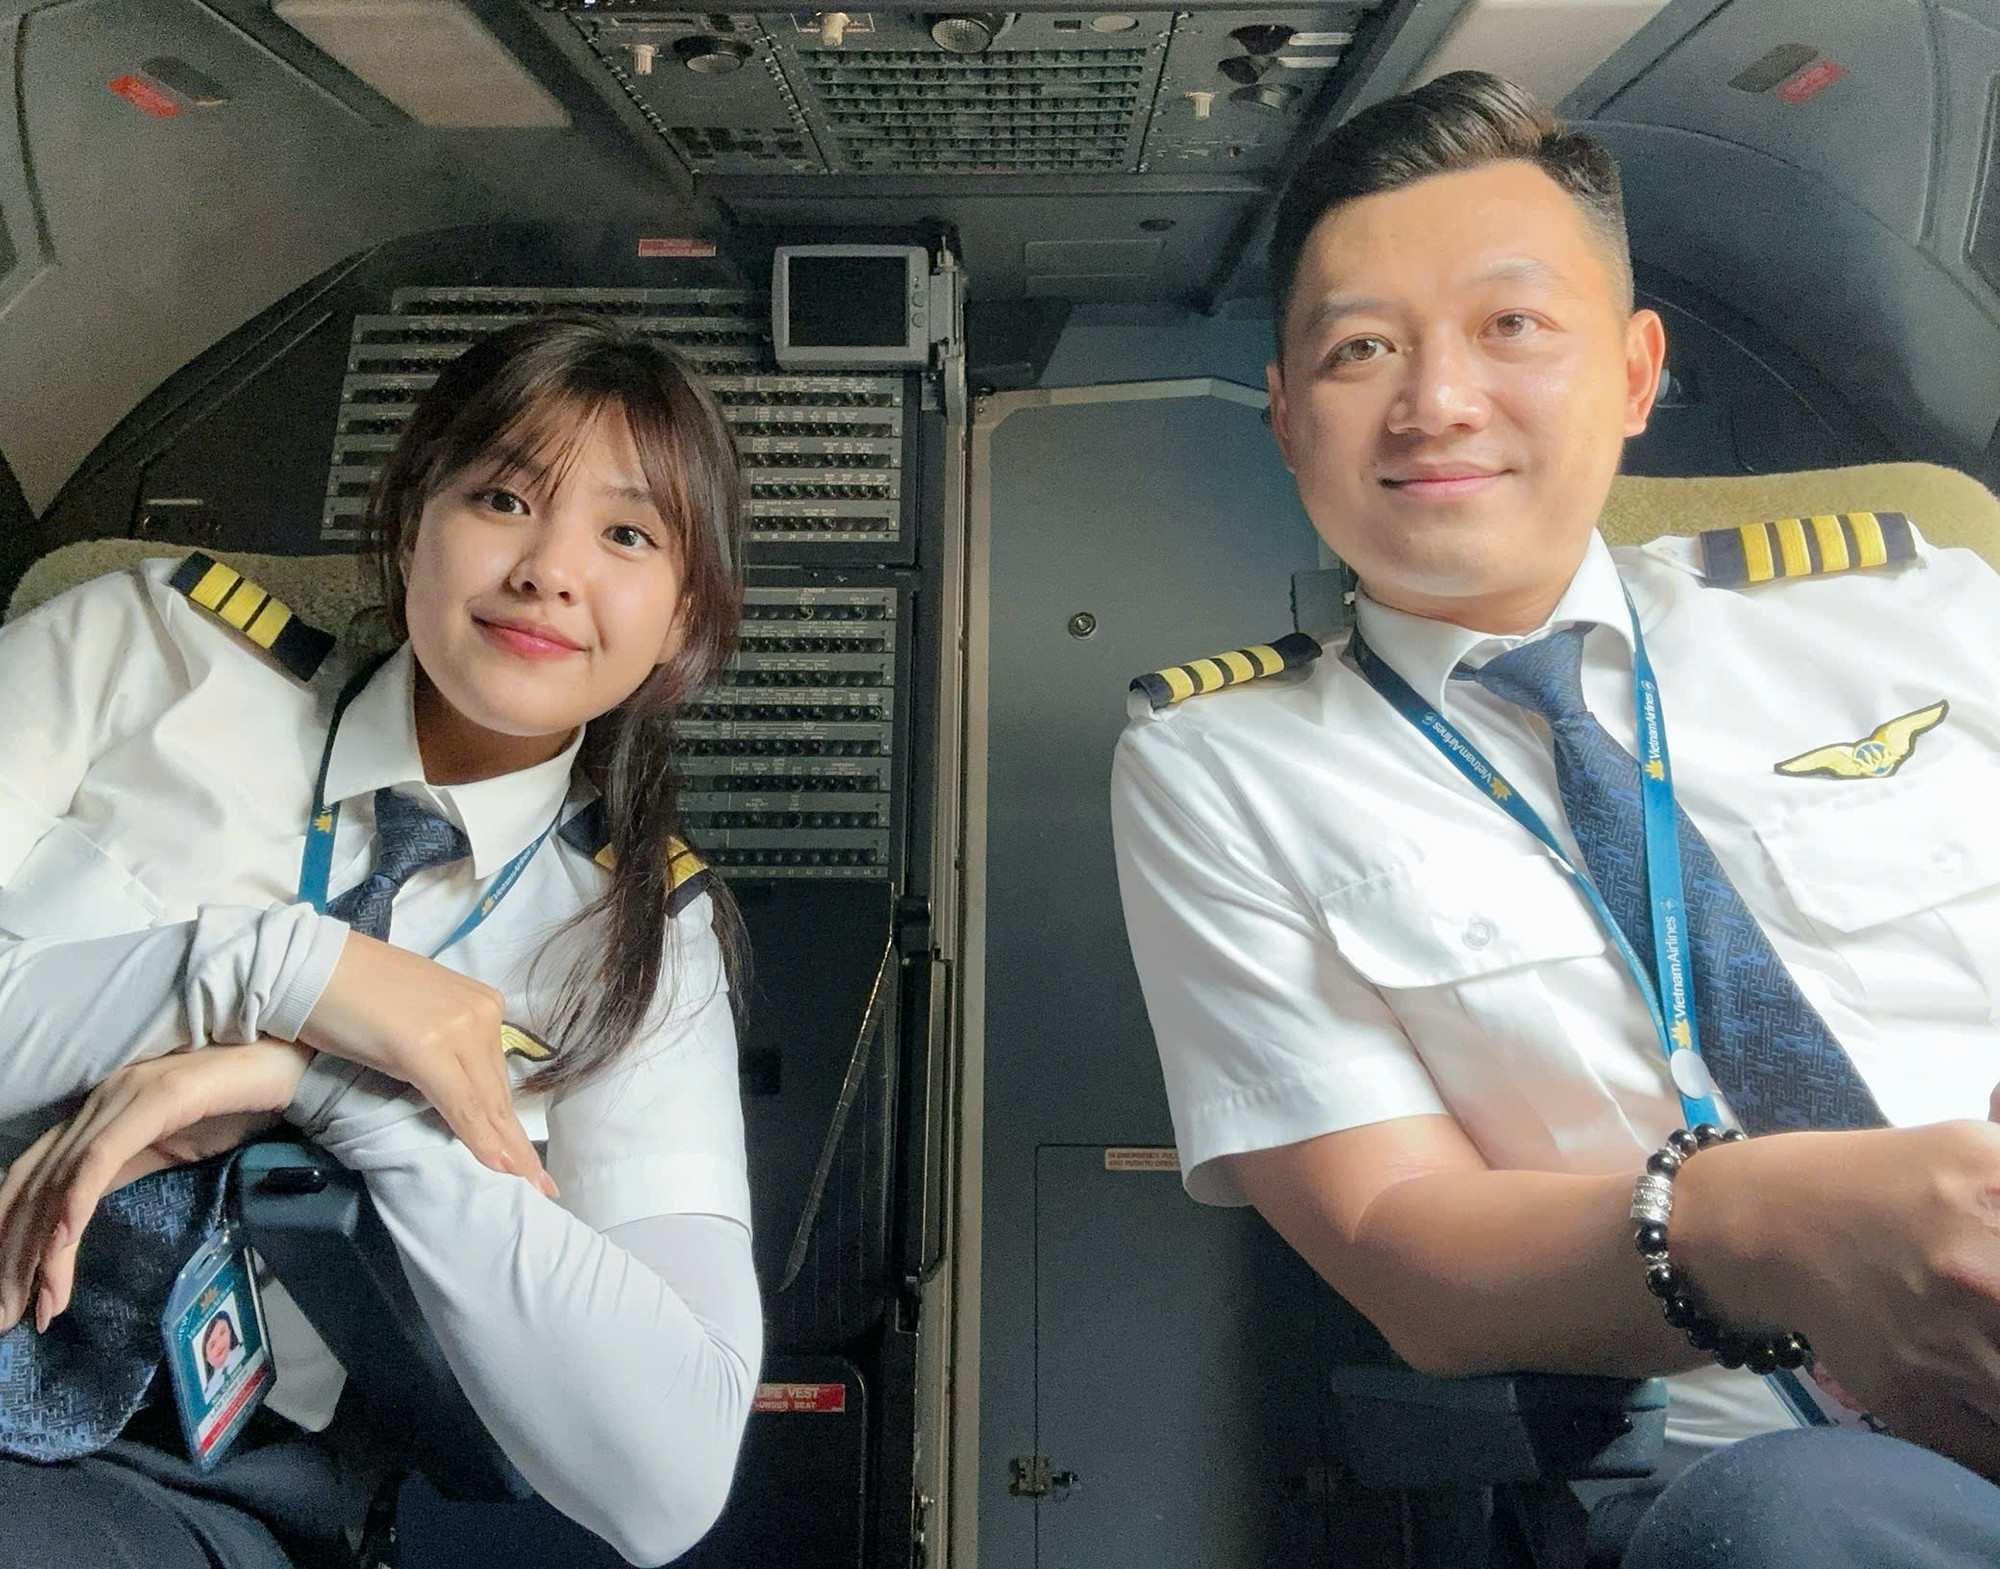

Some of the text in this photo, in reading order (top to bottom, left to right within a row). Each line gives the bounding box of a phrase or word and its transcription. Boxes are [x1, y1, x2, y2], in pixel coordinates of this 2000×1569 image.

[1432, 721, 1492, 783] VietnamAirlines
[1665, 915, 1687, 1019] VietnamAirlines
[787, 1386, 820, 1399] VEST
[794, 1401, 817, 1410] SEAT
